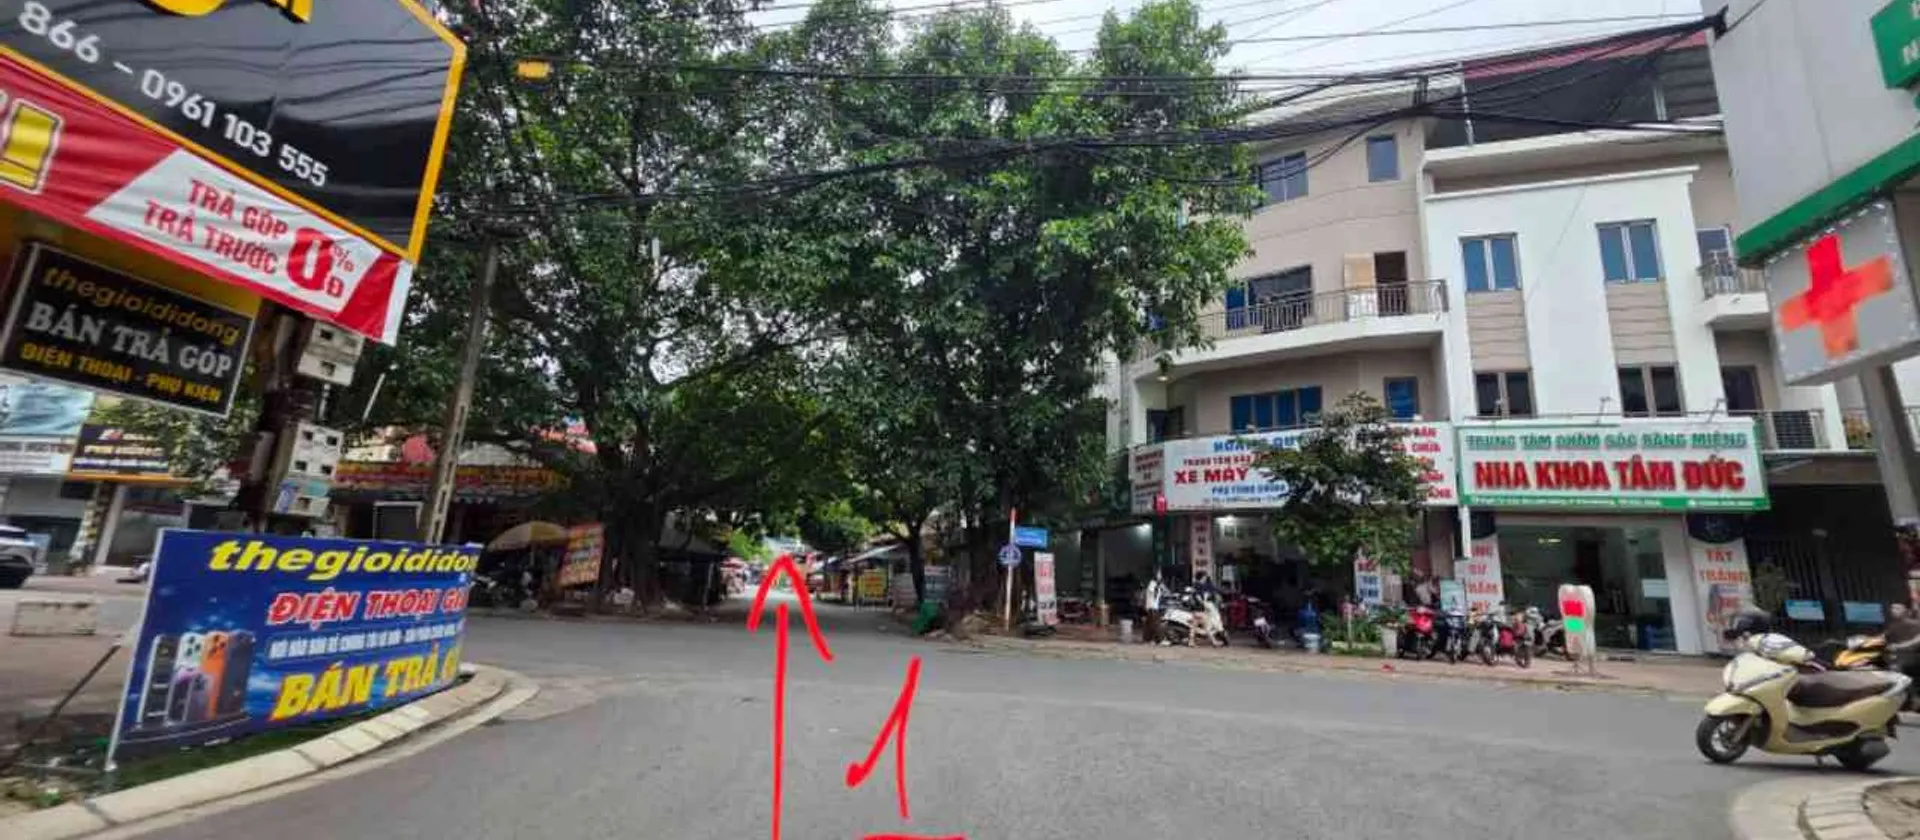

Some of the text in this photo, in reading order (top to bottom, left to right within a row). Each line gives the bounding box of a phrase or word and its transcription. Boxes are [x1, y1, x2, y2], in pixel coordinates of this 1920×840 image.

[18, 2, 100, 63] 866
[141, 69, 216, 128] 0961
[223, 113, 272, 158] 103
[279, 143, 328, 187] 555
[143, 200, 278, 275] TRẢ TRƯỚC
[188, 179, 288, 240] TRẢ GÓP
[25, 301, 232, 379] BÁN TRẢ GÓP
[43, 267, 241, 346] thegioididong
[1175, 470, 1197, 485] XE
[1474, 454, 1745, 491] NHA KHOA TÂM ĐỨC
[265, 586, 361, 631] ĐIỆN
[363, 588, 442, 620] THOẠI
[268, 660, 381, 722] BÁN
[382, 642, 440, 699] TRẢ
